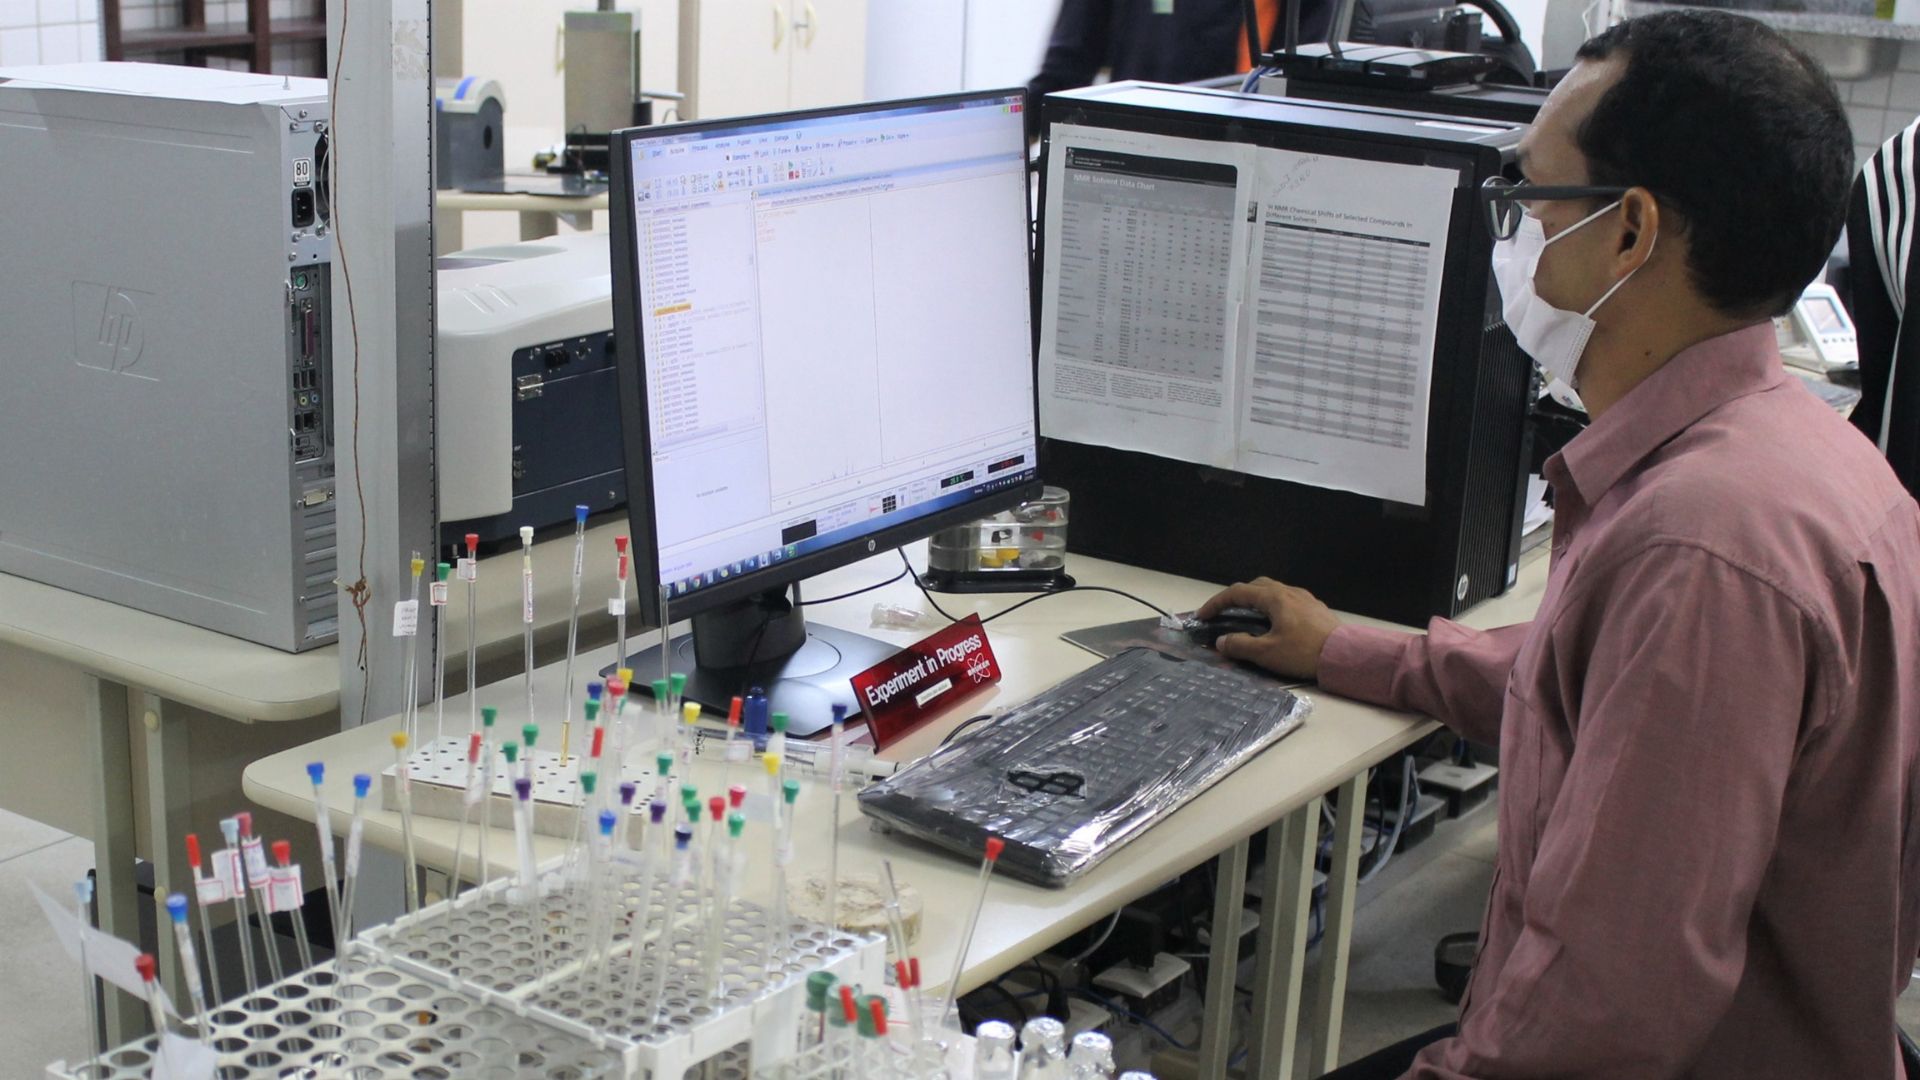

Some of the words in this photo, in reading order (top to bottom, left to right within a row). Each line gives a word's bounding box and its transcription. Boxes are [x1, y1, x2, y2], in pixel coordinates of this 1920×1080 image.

[296, 161, 308, 176] 80
[1092, 175, 1118, 186] Solvent
[1119, 178, 1136, 188] Data
[1136, 180, 1155, 191] Chart
[1289, 206, 1317, 216] Chemical
[1317, 209, 1335, 218] Shifts
[1343, 213, 1369, 223] Selected
[1369, 216, 1405, 228] Compounds
[865, 660, 927, 706] Experiment
[924, 655, 939, 674] in
[937, 634, 982, 667] Progress
